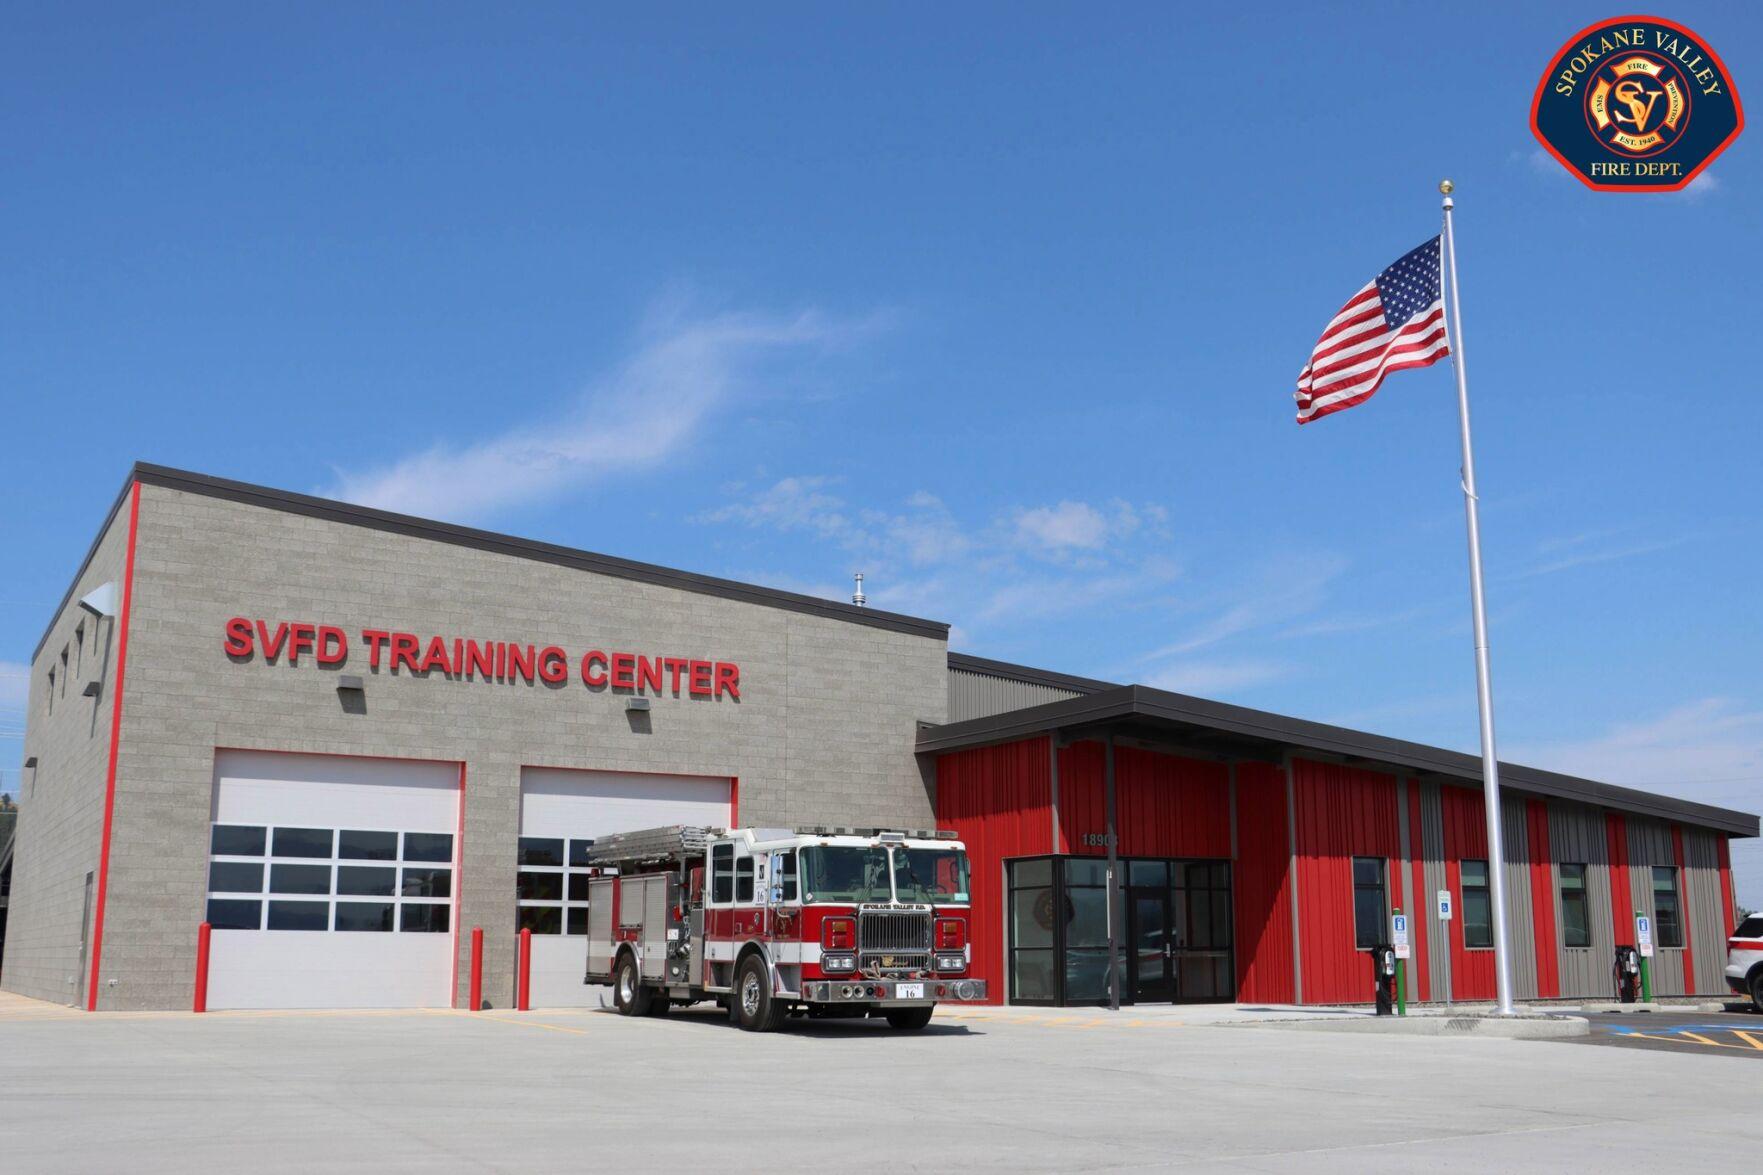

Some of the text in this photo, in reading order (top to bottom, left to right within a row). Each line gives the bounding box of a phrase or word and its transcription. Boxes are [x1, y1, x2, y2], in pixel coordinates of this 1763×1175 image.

[224, 617, 741, 699] SVFD TRAINING CENTER
[906, 989, 916, 998] 16
